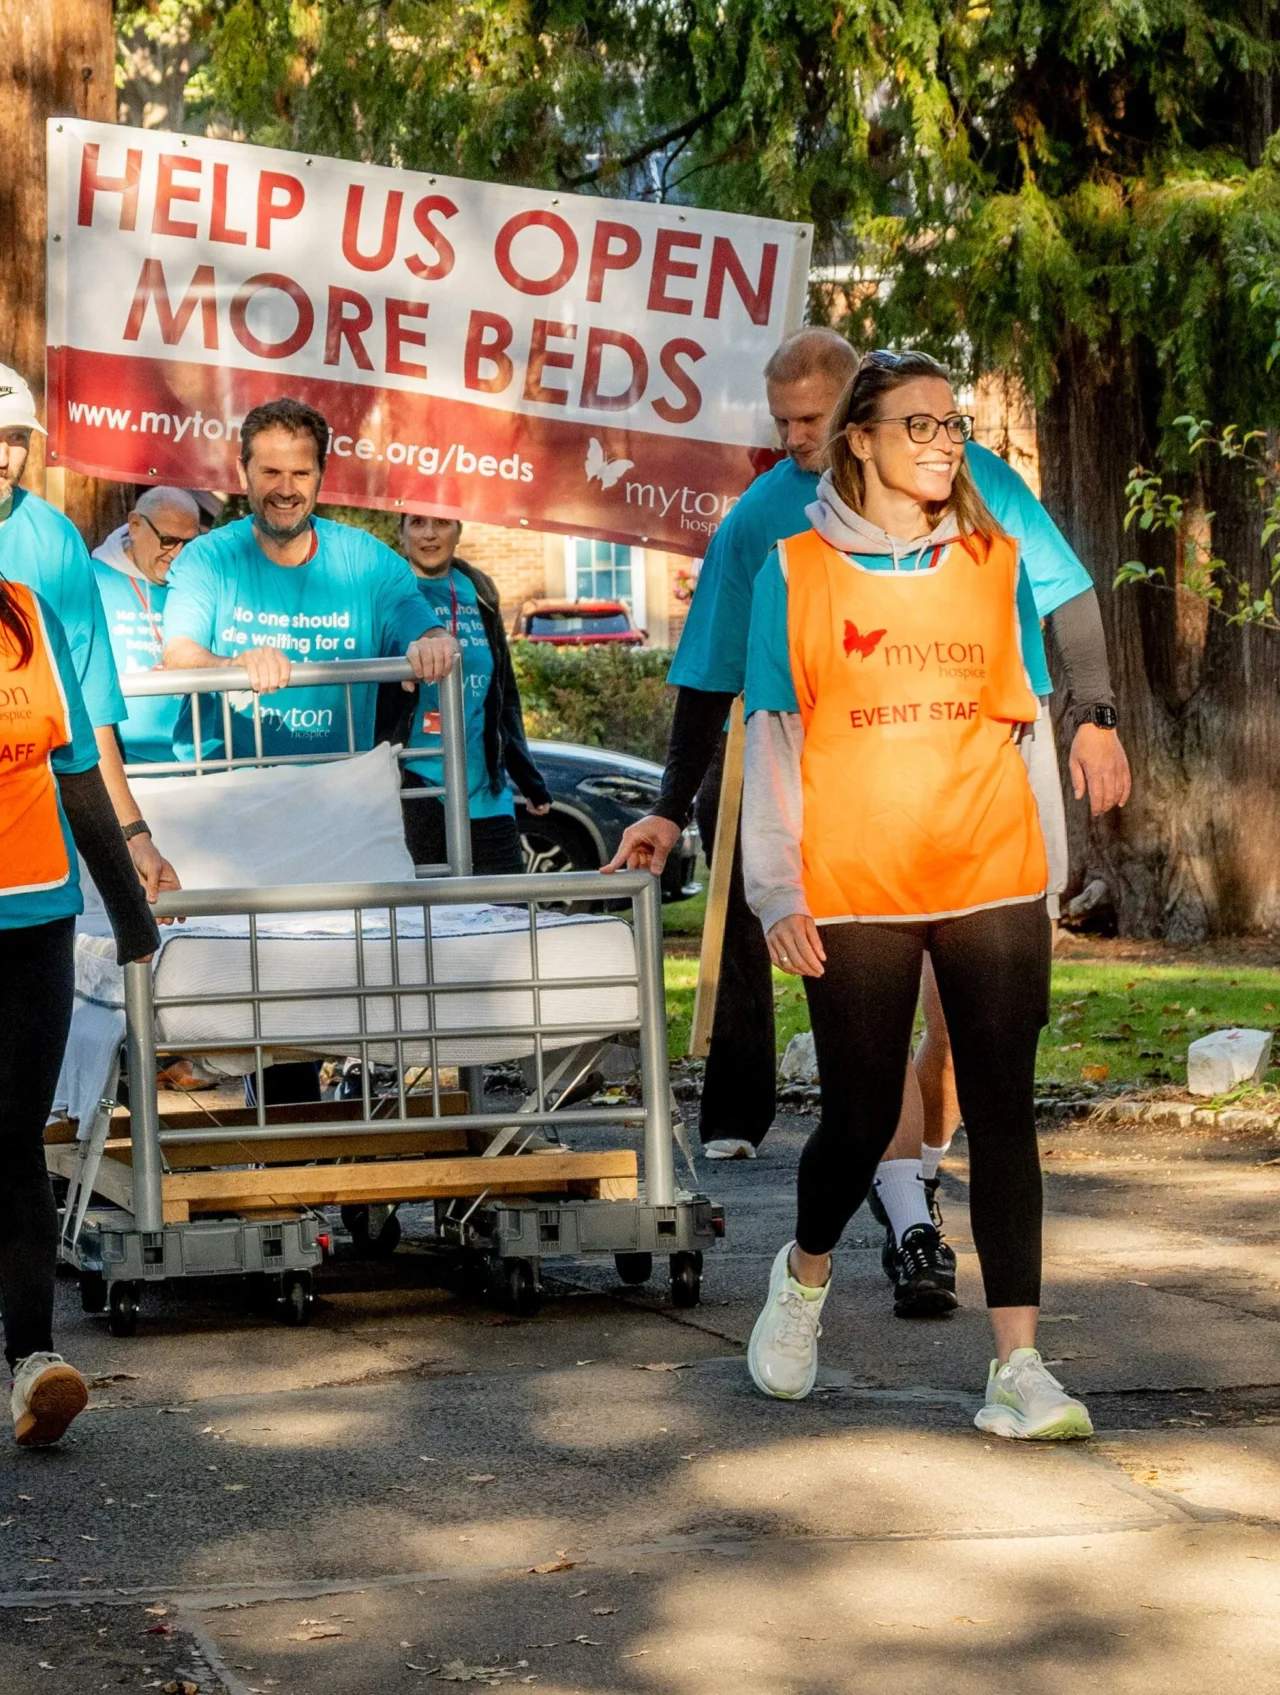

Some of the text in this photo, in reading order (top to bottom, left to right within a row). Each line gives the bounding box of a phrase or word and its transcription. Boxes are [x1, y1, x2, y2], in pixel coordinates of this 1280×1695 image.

[77, 142, 779, 326] HELP US OPEN
[123, 258, 706, 424] MORE BEDS
[67, 400, 534, 482] www.mytonice.org/beds
[680, 514, 718, 536] hosp
[258, 612, 290, 627] one
[292, 611, 350, 628] should
[221, 626, 356, 654] die waiting for a
[884, 641, 984, 671] myton
[939, 666, 986, 681] hospice
[849, 702, 979, 728] EVENT STAF
[290, 727, 331, 740] hospice
